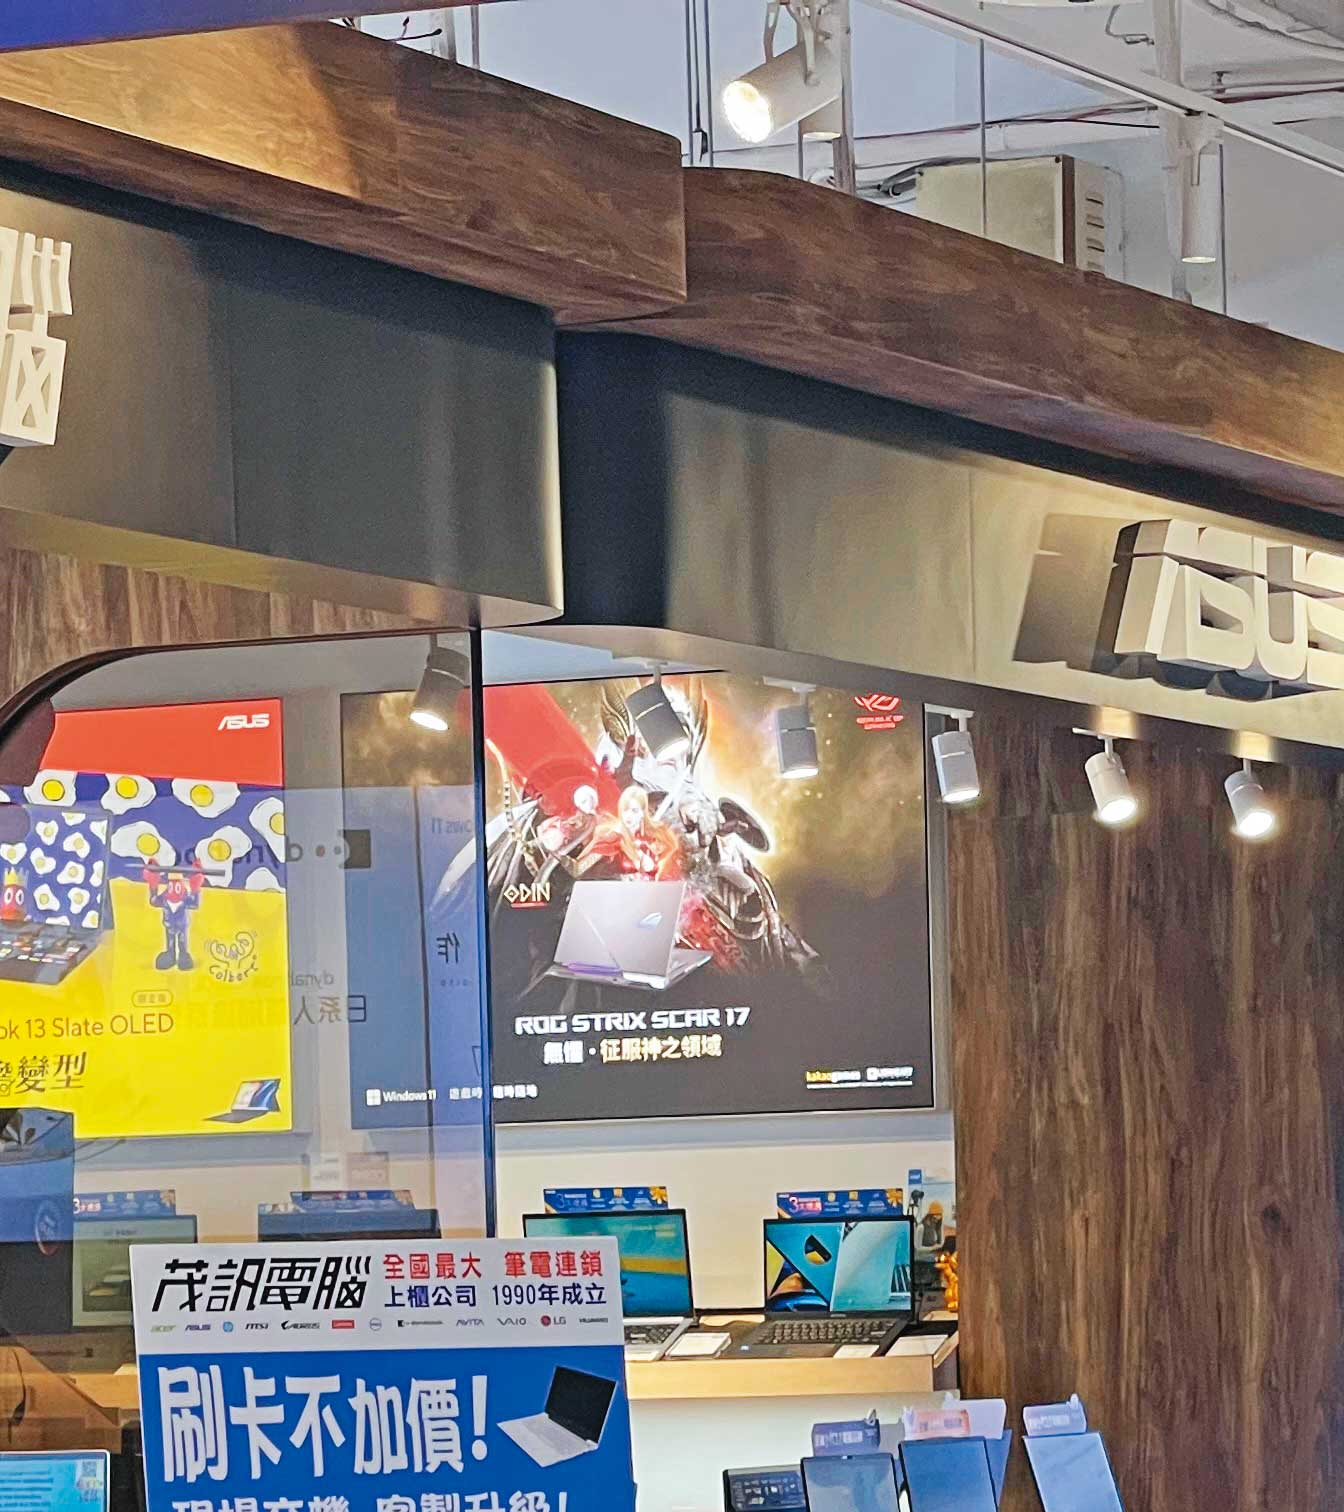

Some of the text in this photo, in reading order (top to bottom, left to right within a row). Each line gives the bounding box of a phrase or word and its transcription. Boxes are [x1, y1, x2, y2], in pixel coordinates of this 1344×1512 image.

[218, 713, 270, 731] ASUS
[504, 882, 551, 903] ODIN
[26, 1017, 46, 1038] 13
[52, 1016, 104, 1038] Slate
[111, 1012, 175, 1036] OLED
[515, 1007, 751, 1035] ROG STRIX SCAR 17
[383, 1250, 604, 1280] 全國最大 筆電連鎖
[151, 1255, 372, 1313] 茂訊電腦
[384, 1283, 607, 1308] 上櫃公司 1990年成立
[184, 1323, 211, 1332] ASUS
[157, 1364, 488, 1484] 刷卡不加價!
